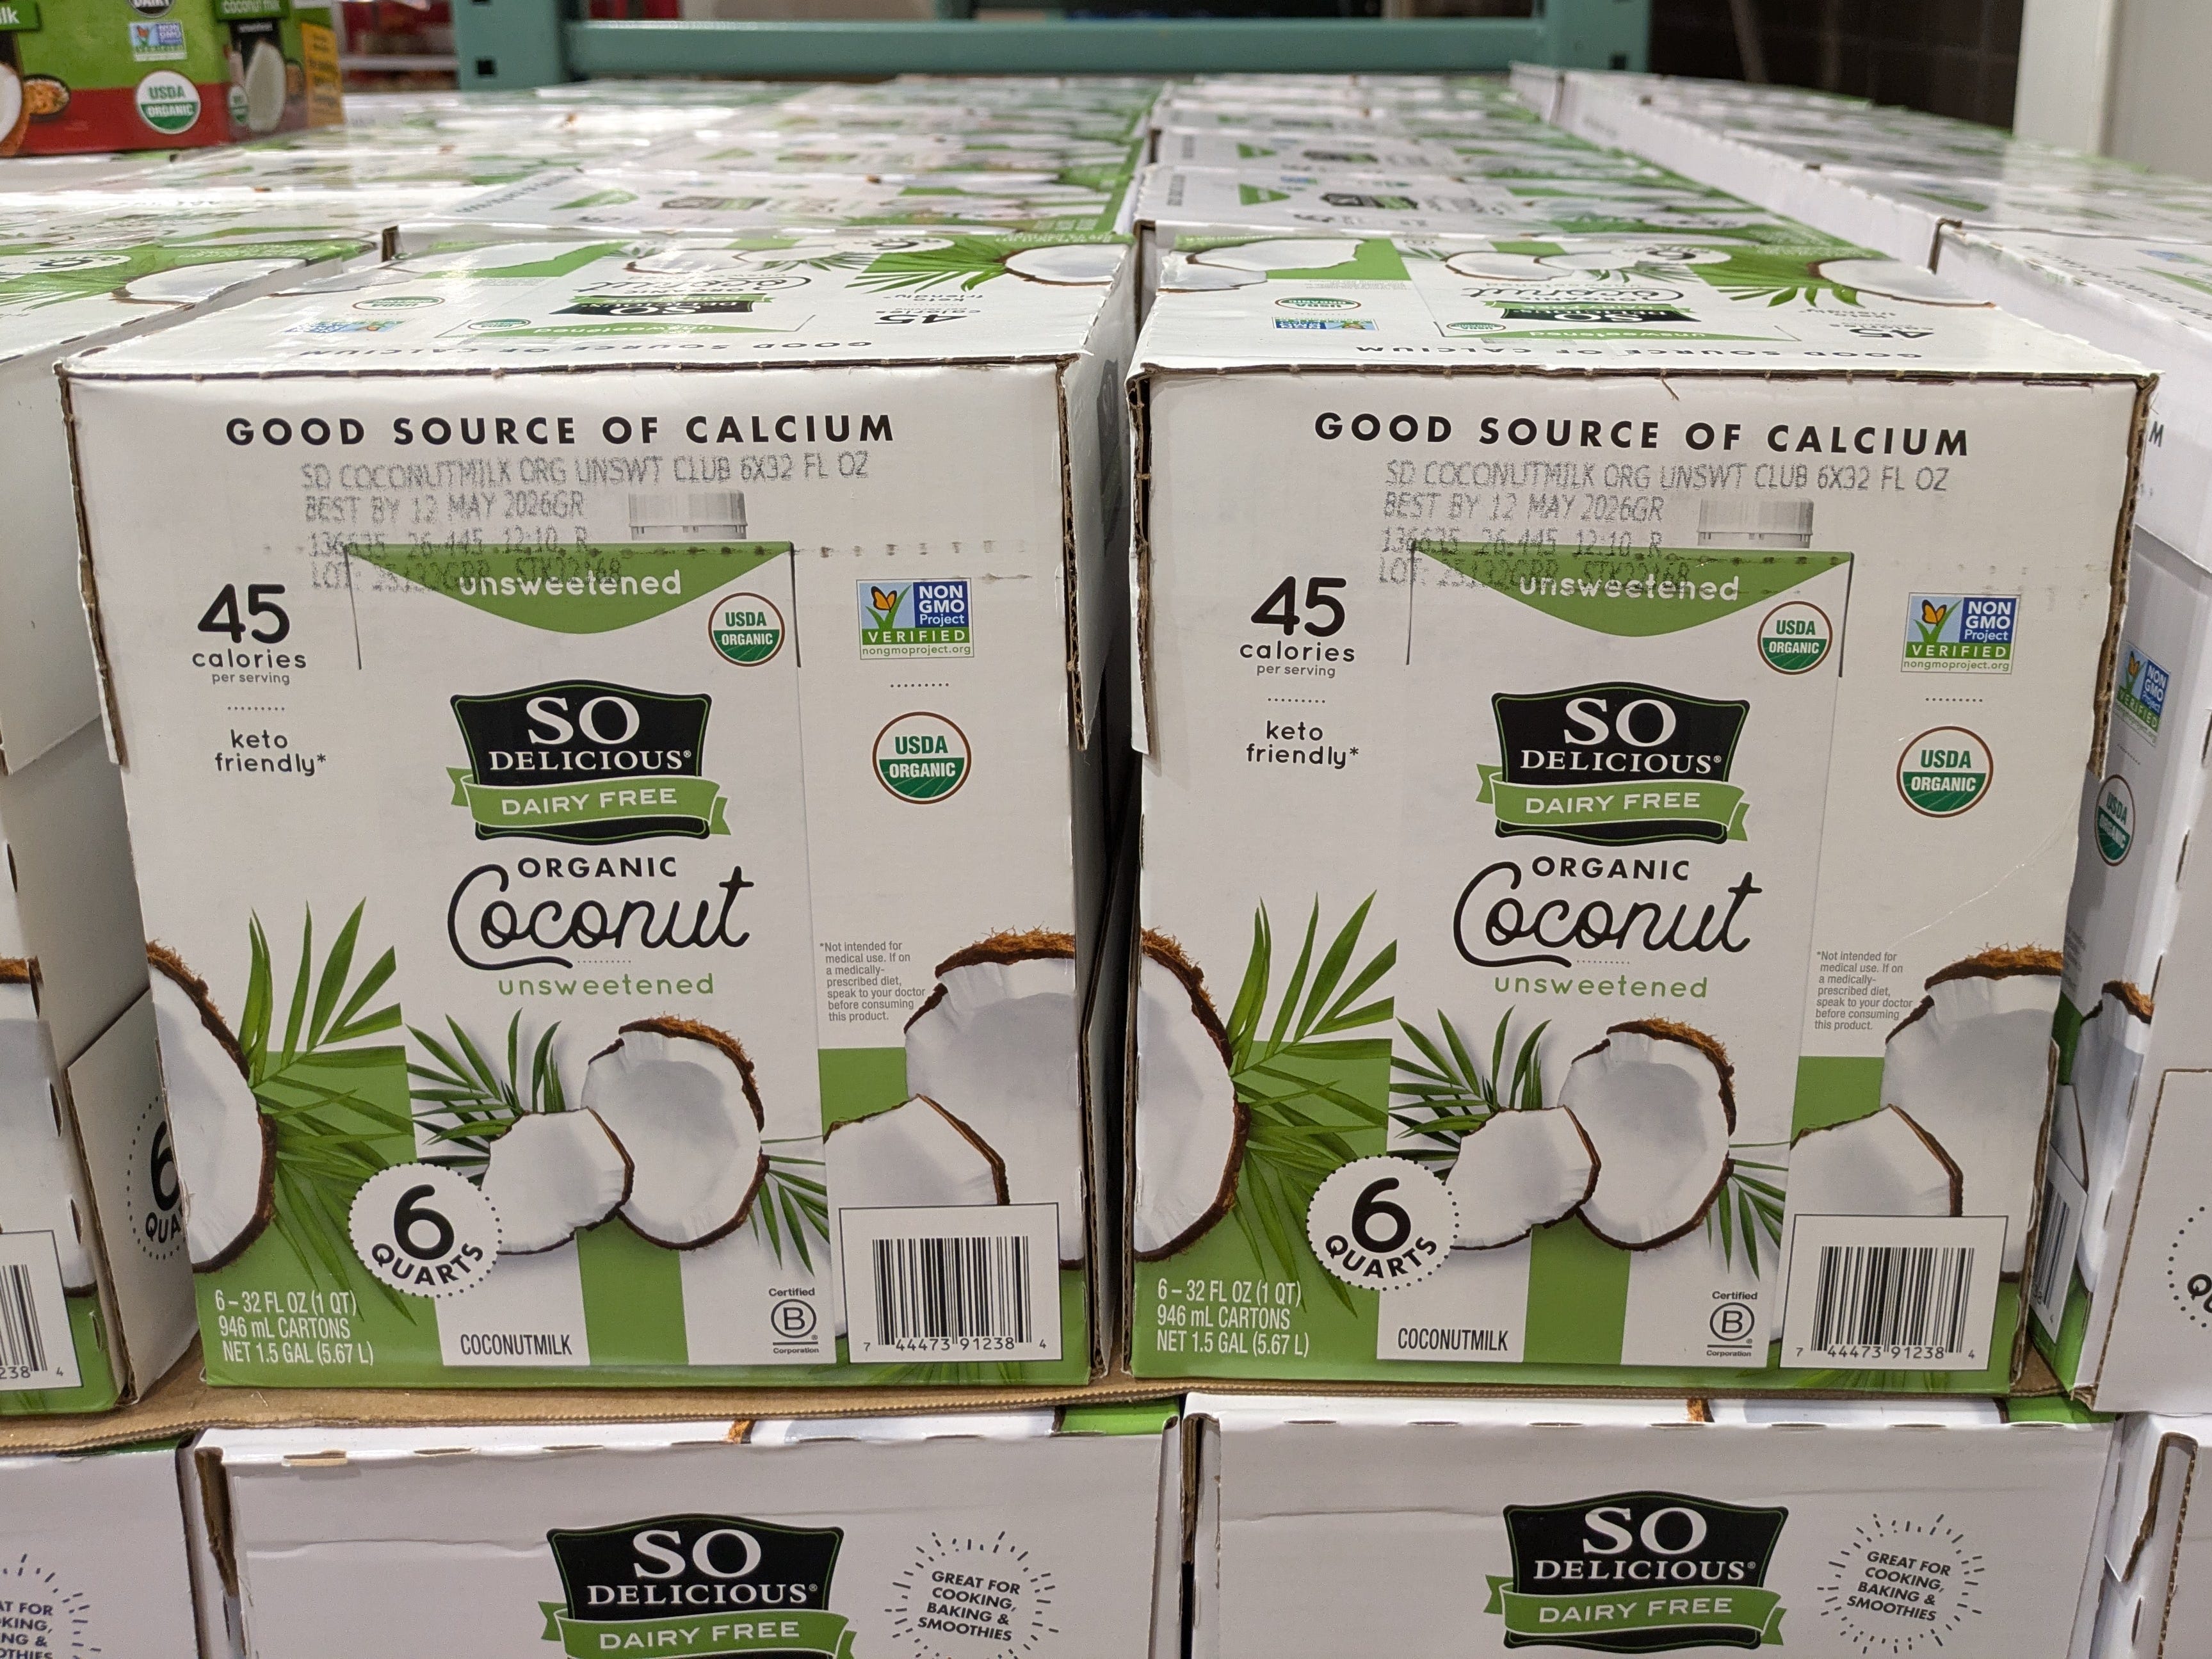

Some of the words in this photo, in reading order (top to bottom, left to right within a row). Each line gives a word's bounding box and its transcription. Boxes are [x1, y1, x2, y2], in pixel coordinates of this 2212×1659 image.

[148, 86, 186, 100] USDA
[147, 104, 193, 117] ORGANIC
[875, 314, 967, 324] 45
[227, 418, 364, 445] GOOD
[393, 417, 575, 445] SOURCE
[602, 416, 658, 444] OF
[686, 415, 893, 443] CALCIUM
[1314, 412, 1452, 442] GOOD
[1479, 417, 1658, 448] SOURCE
[1686, 422, 1741, 451] OF
[1768, 425, 1967, 456] CALCIUM
[520, 456, 567, 484] ORG
[673, 455, 731, 483] CLUB
[803, 452, 828, 479] FL
[837, 451, 869, 478] OZ
[458, 569, 681, 596] unsweetened
[919, 585, 964, 599] NON
[1520, 575, 1740, 602] unsweetened
[197, 583, 290, 644] 45
[919, 599, 965, 613] GMO
[1251, 576, 1346, 637] 45
[1968, 601, 2011, 615] NON
[725, 611, 767, 627] USDA
[919, 613, 965, 627] Project
[1776, 620, 1816, 636] USDA
[1966, 615, 2011, 630] GMO
[721, 633, 773, 646] ORGANIC
[868, 630, 965, 643] VERIFIED
[1964, 629, 2008, 642] Project
[192, 649, 307, 668] calories
[862, 645, 971, 658] nongmoproject.org
[1239, 640, 1355, 662] calories
[1768, 642, 1820, 654] ORGANIC
[1912, 644, 2006, 658] VERIFIED
[1257, 664, 1280, 676] per
[1284, 665, 1336, 679] serving
[1903, 660, 2010, 672] nongmoproject.org
[213, 673, 235, 684] per
[239, 672, 290, 685] serving
[526, 696, 640, 745] SO
[1266, 720, 1323, 741] keto
[1563, 697, 1676, 747] SO
[230, 729, 288, 749] keto
[894, 735, 949, 756] USDA
[1920, 750, 1971, 768] USDA
[889, 762, 956, 779] ORGANIC
[1910, 776, 1976, 792] ORGANIC
[502, 794, 592, 816] DAIRY
[599, 788, 677, 809] FREE
[1526, 795, 1615, 814] DAIRY
[1624, 791, 1700, 809] FREE
[518, 857, 677, 878] ORGANIC
[1532, 855, 1689, 882] ORGANIC
[448, 864, 754, 971] Coconut
[1453, 861, 1763, 968] Coconut
[844, 941, 886, 952] intended
[889, 941, 903, 951] for
[825, 953, 864, 964] medical
[866, 955, 887, 964] use.
[889, 952, 896, 962] If
[898, 953, 911, 962] on
[826, 967, 832, 976] a
[835, 965, 885, 978] medically-
[827, 976, 878, 989] prescribed
[880, 976, 902, 988] diet,
[498, 973, 714, 996] unsweetened
[827, 988, 856, 1000] speak
[859, 989, 868, 998] to
[870, 989, 892, 1001] your
[895, 987, 926, 998] doctor
[1495, 975, 1707, 998] unsweetened
[828, 1000, 859, 1010] before
[862, 999, 914, 1011] consuming
[828, 1012, 846, 1021] this
[849, 1011, 889, 1023] product.
[151, 1121, 180, 1211] 6
[394, 1184, 455, 1261] 6
[1352, 1177, 1411, 1253] 6
[145, 1212, 183, 1243] QUA
[371, 1242, 483, 1286] QUARTS
[1325, 1234, 1437, 1279] QUARTS
[768, 1287, 815, 1297] Certified
[1158, 1279, 1168, 1300] 6
[1186, 1281, 1205, 1302] 32
[1209, 1282, 1227, 1302] FL
[1232, 1283, 1252, 1304] OZ
[1255, 1281, 1270, 1306] (1
[1274, 1283, 1302, 1307] QT)
[1711, 1291, 1758, 1300] Certified
[215, 1290, 225, 1312] 6
[242, 1291, 261, 1313] 32
[266, 1291, 284, 1313] FL
[287, 1292, 309, 1314] OZ
[311, 1291, 325, 1317] (1
[329, 1291, 357, 1316] QT)
[218, 1316, 247, 1338] 946
[251, 1317, 275, 1338] mL
[278, 1317, 351, 1339] CARTONS
[1156, 1306, 1186, 1327] 946
[1190, 1307, 1215, 1328] mL
[1218, 1307, 1291, 1331] CARTONS
[460, 1334, 572, 1356] COCONUTMILK
[896, 1338, 951, 1352] 44473
[961, 1338, 1015, 1351] 91238
[1156, 1331, 1188, 1352] NET
[1191, 1331, 1214, 1353] 1.5
[1218, 1332, 1249, 1354] GAL
[1252, 1332, 1289, 1357] (5.67
[1293, 1333, 1310, 1358] L)
[1398, 1327, 1508, 1352] COCONUTMILK
[223, 1341, 250, 1363] NET
[256, 1341, 279, 1363] 1.5
[282, 1342, 313, 1364] GAL
[317, 1341, 355, 1365] (5.67
[359, 1342, 374, 1366] L)
[773, 1347, 819, 1355] Corporation
[1827, 1345, 1882, 1359] 44473
[1891, 1346, 1944, 1359] 91238
[1582, 1507, 1707, 1556] SO
[633, 1529, 762, 1579] SO
[1866, 1550, 1916, 1571] GREAT
[1920, 1559, 1952, 1577] FOR
[932, 1570, 983, 1590] GREAT
[987, 1578, 1021, 1596] FOR
[1865, 1567, 1946, 1593] COOKING,
[932, 1587, 1017, 1612] COOKING,
[1857, 1581, 1921, 1605] BAKING
[1924, 1592, 1936, 1606] &
[19, 1603, 53, 1616] FOR
[926, 1602, 992, 1624] BAKING
[997, 1612, 1010, 1626] &
[1539, 1601, 1638, 1624] DAIRY
[1647, 1597, 1732, 1616] FREE
[1846, 1594, 1937, 1623] SMOOTHIES
[599, 1626, 700, 1649] DAIRY
[712, 1621, 800, 1641] FREE
[917, 1617, 1013, 1642] SMOOTHIES
